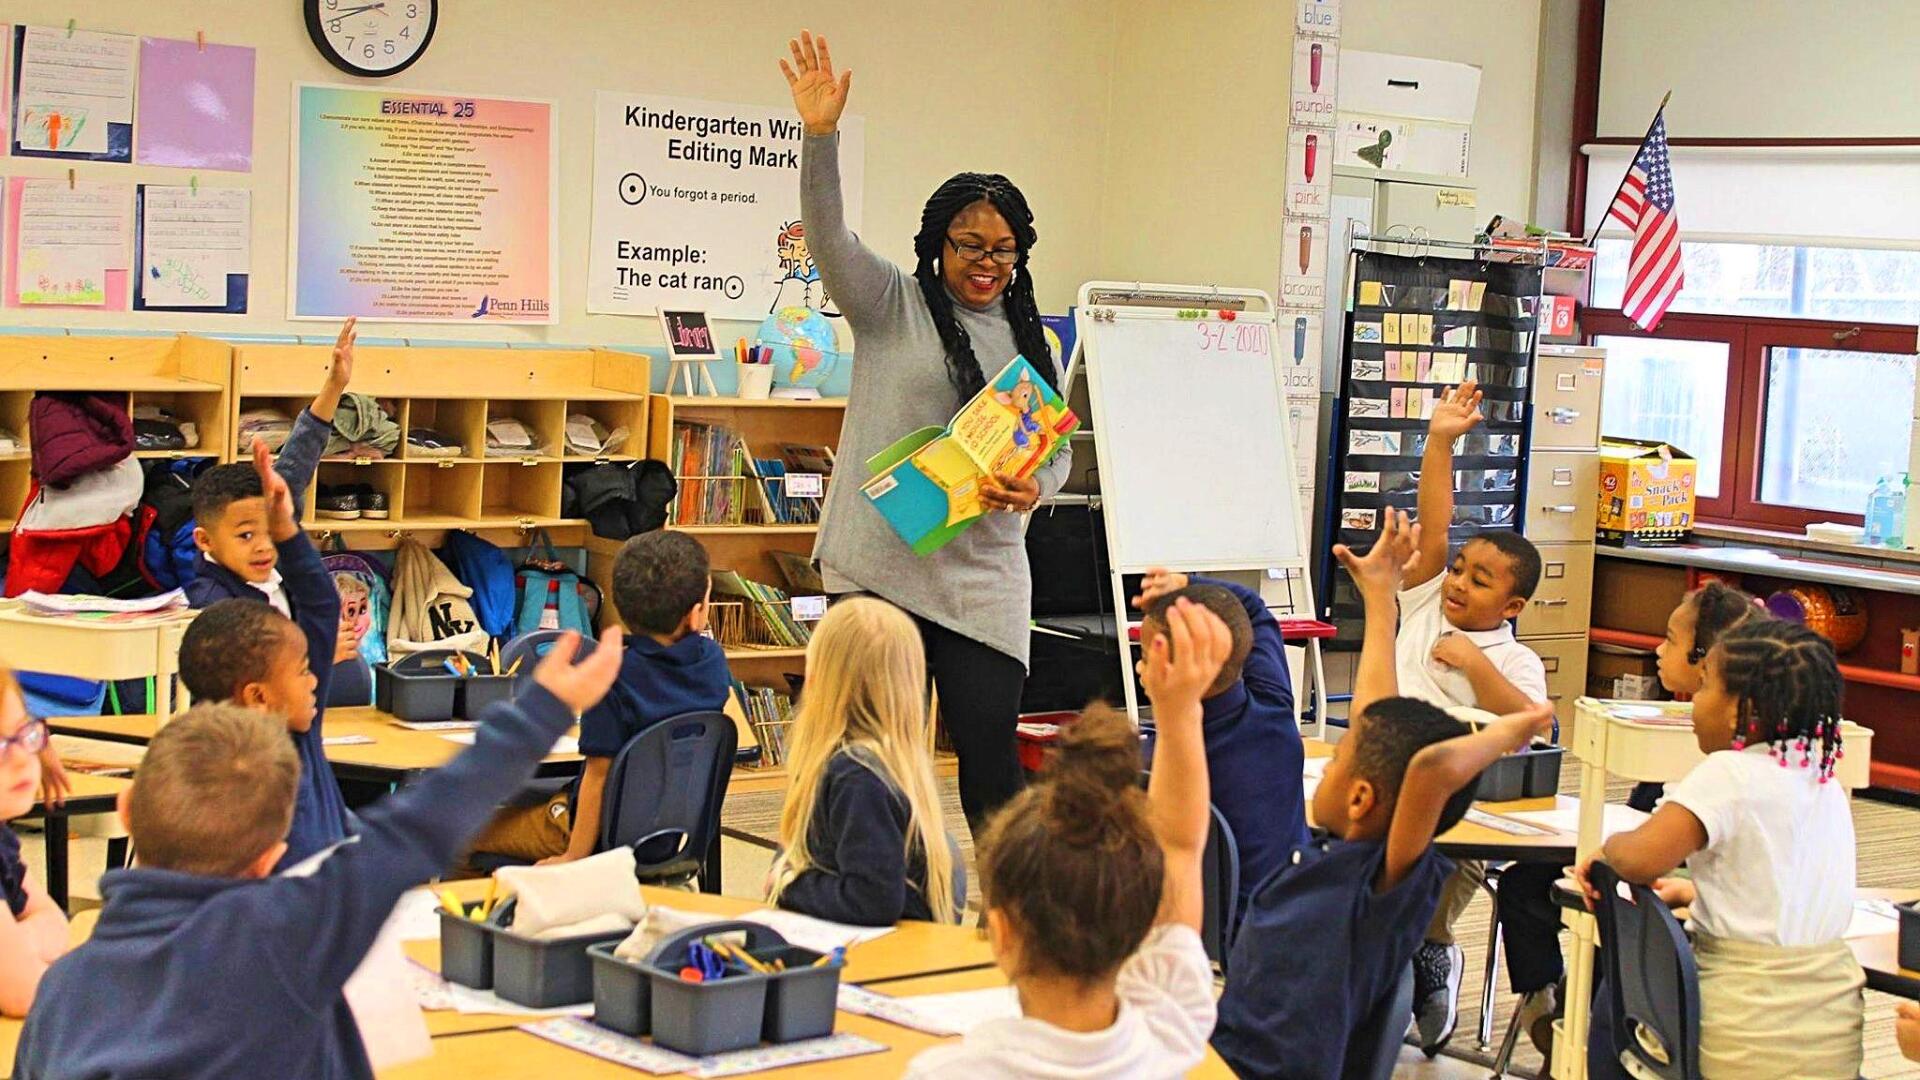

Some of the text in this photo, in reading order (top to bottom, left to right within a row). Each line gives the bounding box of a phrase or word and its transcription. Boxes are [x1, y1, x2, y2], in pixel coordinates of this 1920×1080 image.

[406, 4, 417, 18] 3
[1304, 4, 1332, 25] blue
[331, 19, 342, 33] 8
[400, 26, 410, 40] 4
[345, 36, 355, 51] 7
[364, 44, 375, 58] 6
[384, 40, 395, 54] 5
[381, 100, 476, 118] ESSENTIAL 25
[1295, 96, 1333, 119] purple
[625, 105, 762, 138] Kindergarten
[668, 139, 798, 169] Editing Mark
[650, 185, 758, 204] You forgot a period.
[1295, 187, 1320, 209] pink
[617, 241, 707, 267] Example:
[616, 268, 724, 291] The cat ran
[1283, 276, 1322, 296] brown
[490, 298, 518, 311] Penn
[520, 299, 550, 312] Hills
[1646, 482, 1680, 496] Snack
[1662, 492, 1687, 507] Pack
